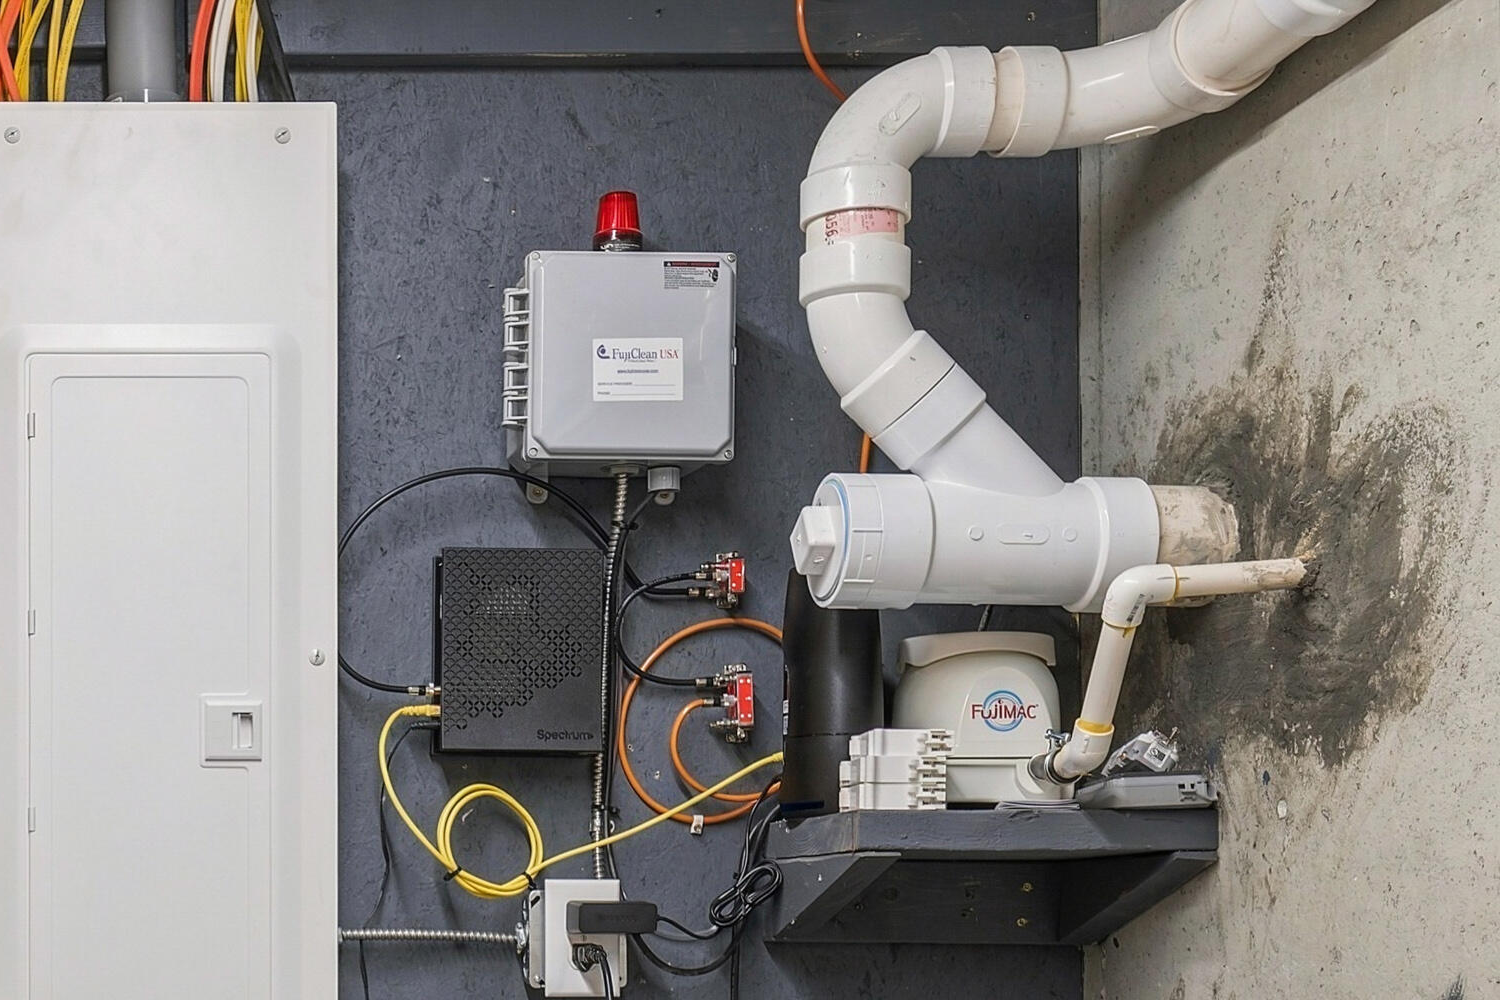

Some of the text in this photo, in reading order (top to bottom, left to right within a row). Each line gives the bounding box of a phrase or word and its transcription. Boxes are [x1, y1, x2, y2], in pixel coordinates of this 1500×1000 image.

[612, 347, 678, 362] FujiClean USA
[536, 729, 589, 742] Spectrum
